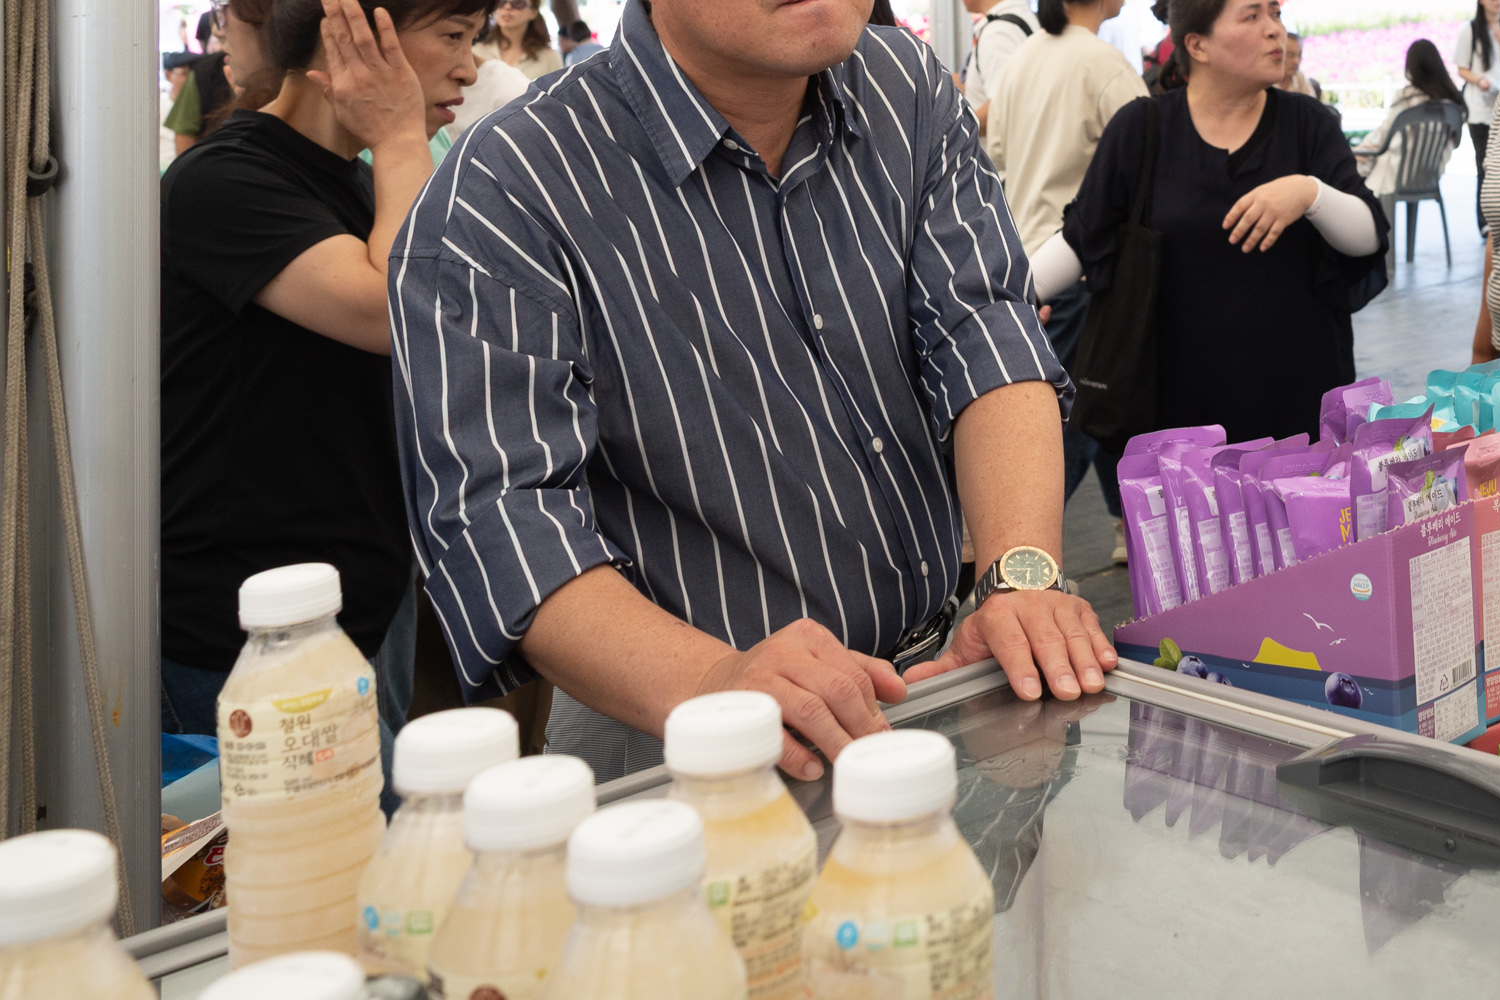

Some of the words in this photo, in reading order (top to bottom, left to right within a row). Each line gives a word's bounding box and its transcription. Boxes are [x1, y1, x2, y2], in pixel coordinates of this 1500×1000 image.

[1339, 506, 1351, 524] JE
[1421, 516, 1444, 538] 블루베리
[1445, 511, 1461, 528] 에이드
[281, 723, 340, 754] 오대쌀
